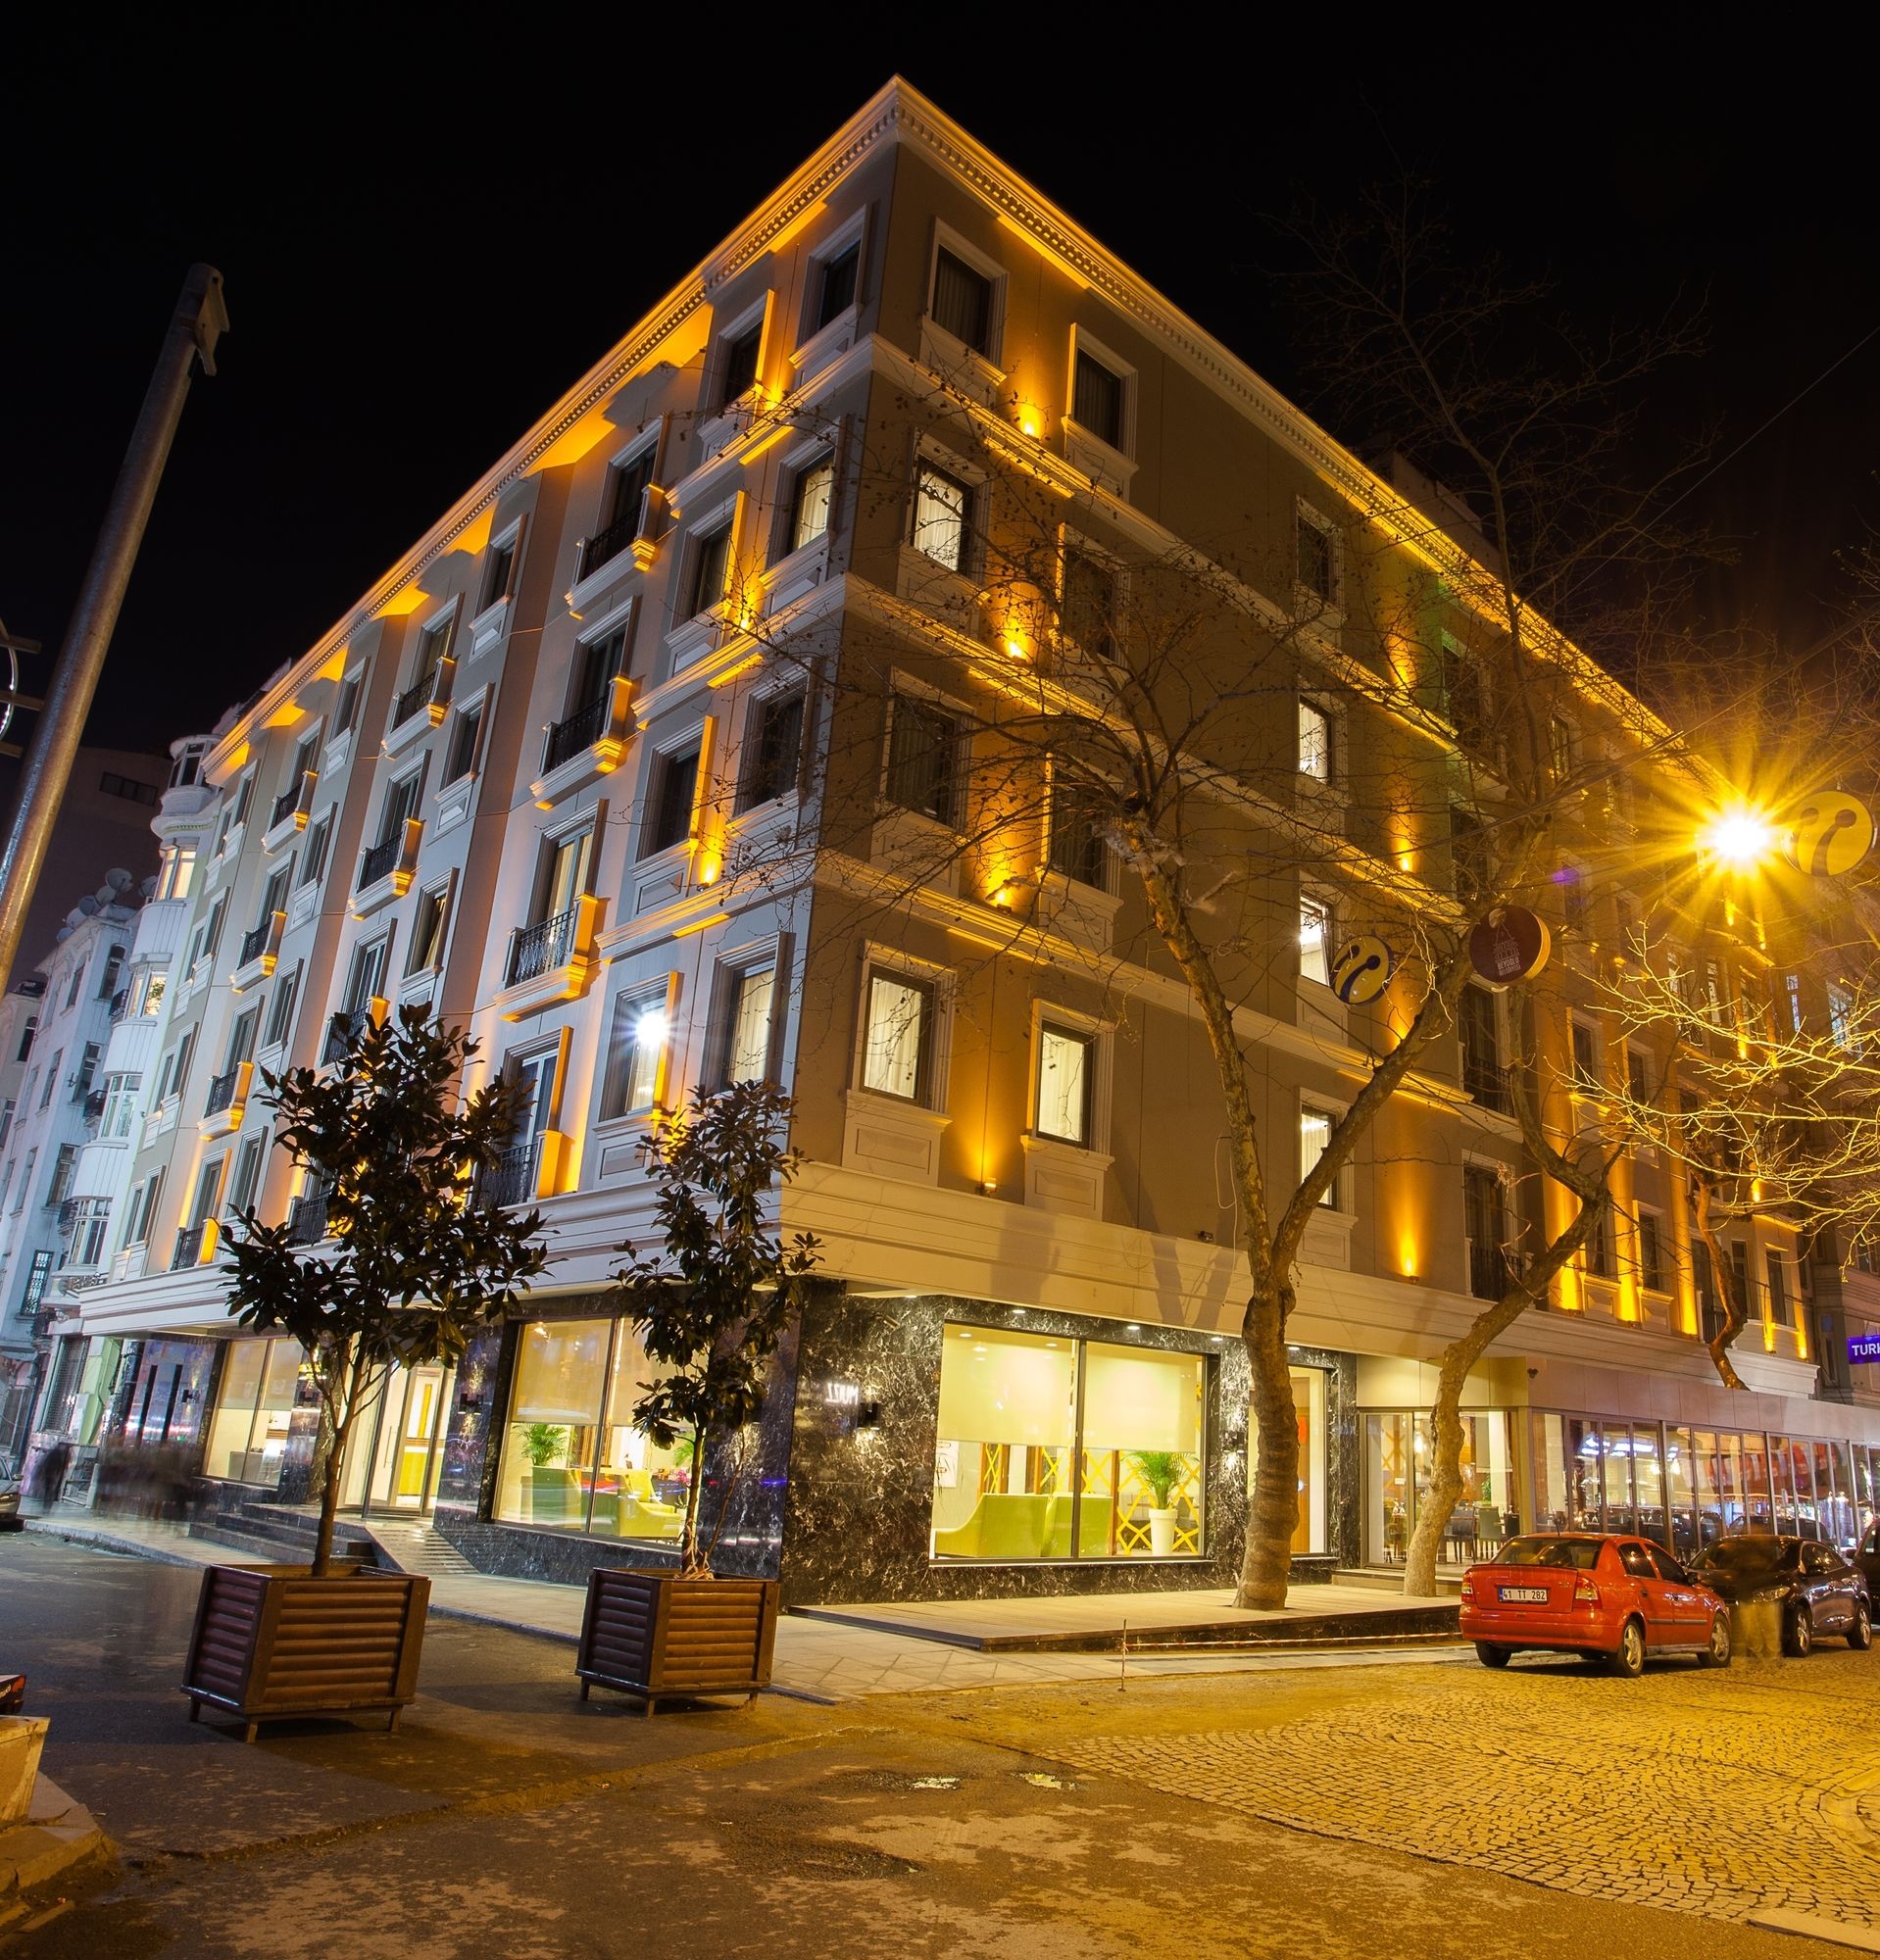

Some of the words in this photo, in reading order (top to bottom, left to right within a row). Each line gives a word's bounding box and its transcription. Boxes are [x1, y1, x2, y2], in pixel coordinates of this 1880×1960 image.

[1504, 1590, 1511, 1598] 41
[1517, 1591, 1526, 1599] TT
[1531, 1591, 1545, 1599] 282
